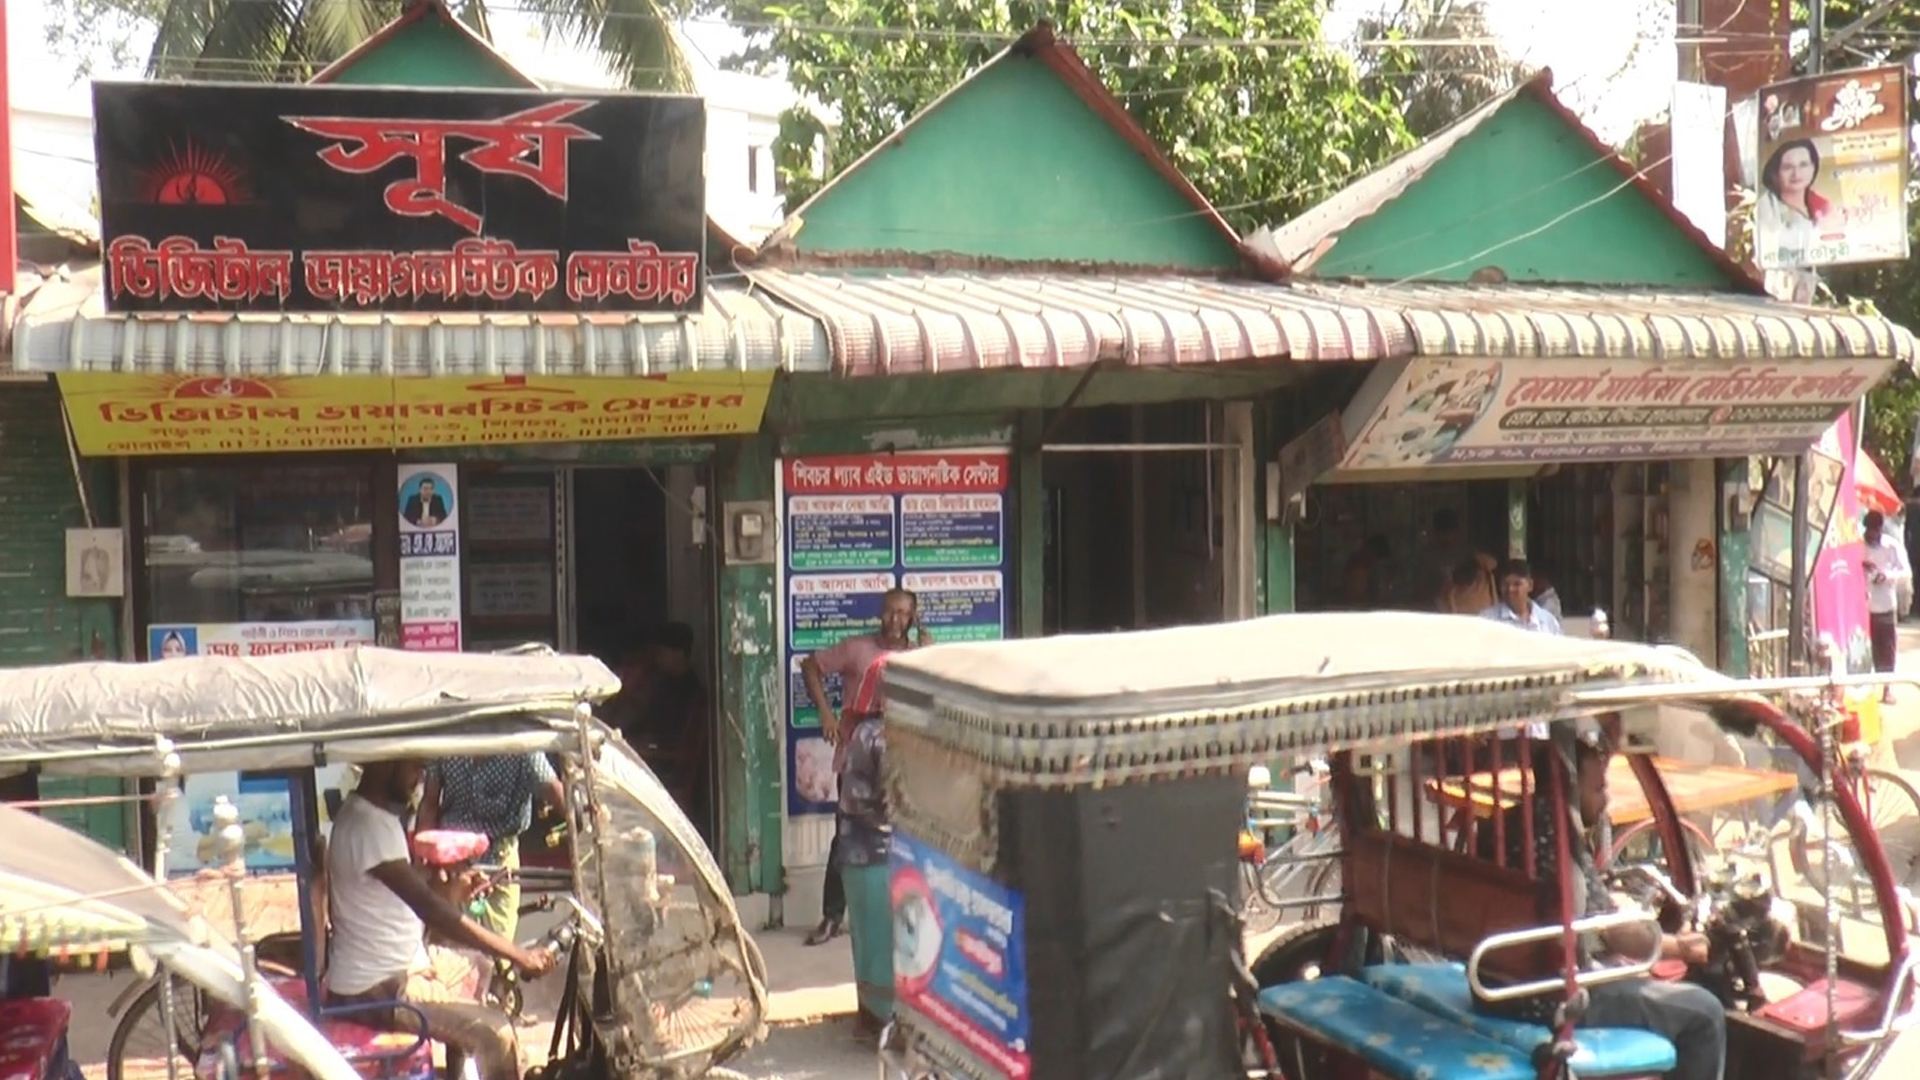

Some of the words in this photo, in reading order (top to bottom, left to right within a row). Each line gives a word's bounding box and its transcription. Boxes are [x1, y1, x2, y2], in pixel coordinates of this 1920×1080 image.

[279, 98, 602, 235] সূর্য
[108, 234, 293, 302] ডিজিটাল
[302, 239, 560, 305] ডায়াগনস্টিক
[566, 238, 699, 305] সেন্টার
[99, 402, 300, 422] ডিজিটাল
[792, 459, 830, 486] শিবচর
[834, 462, 862, 487] ল্যাব
[865, 460, 894, 485] এইড
[963, 459, 999, 484] সেন্টার
